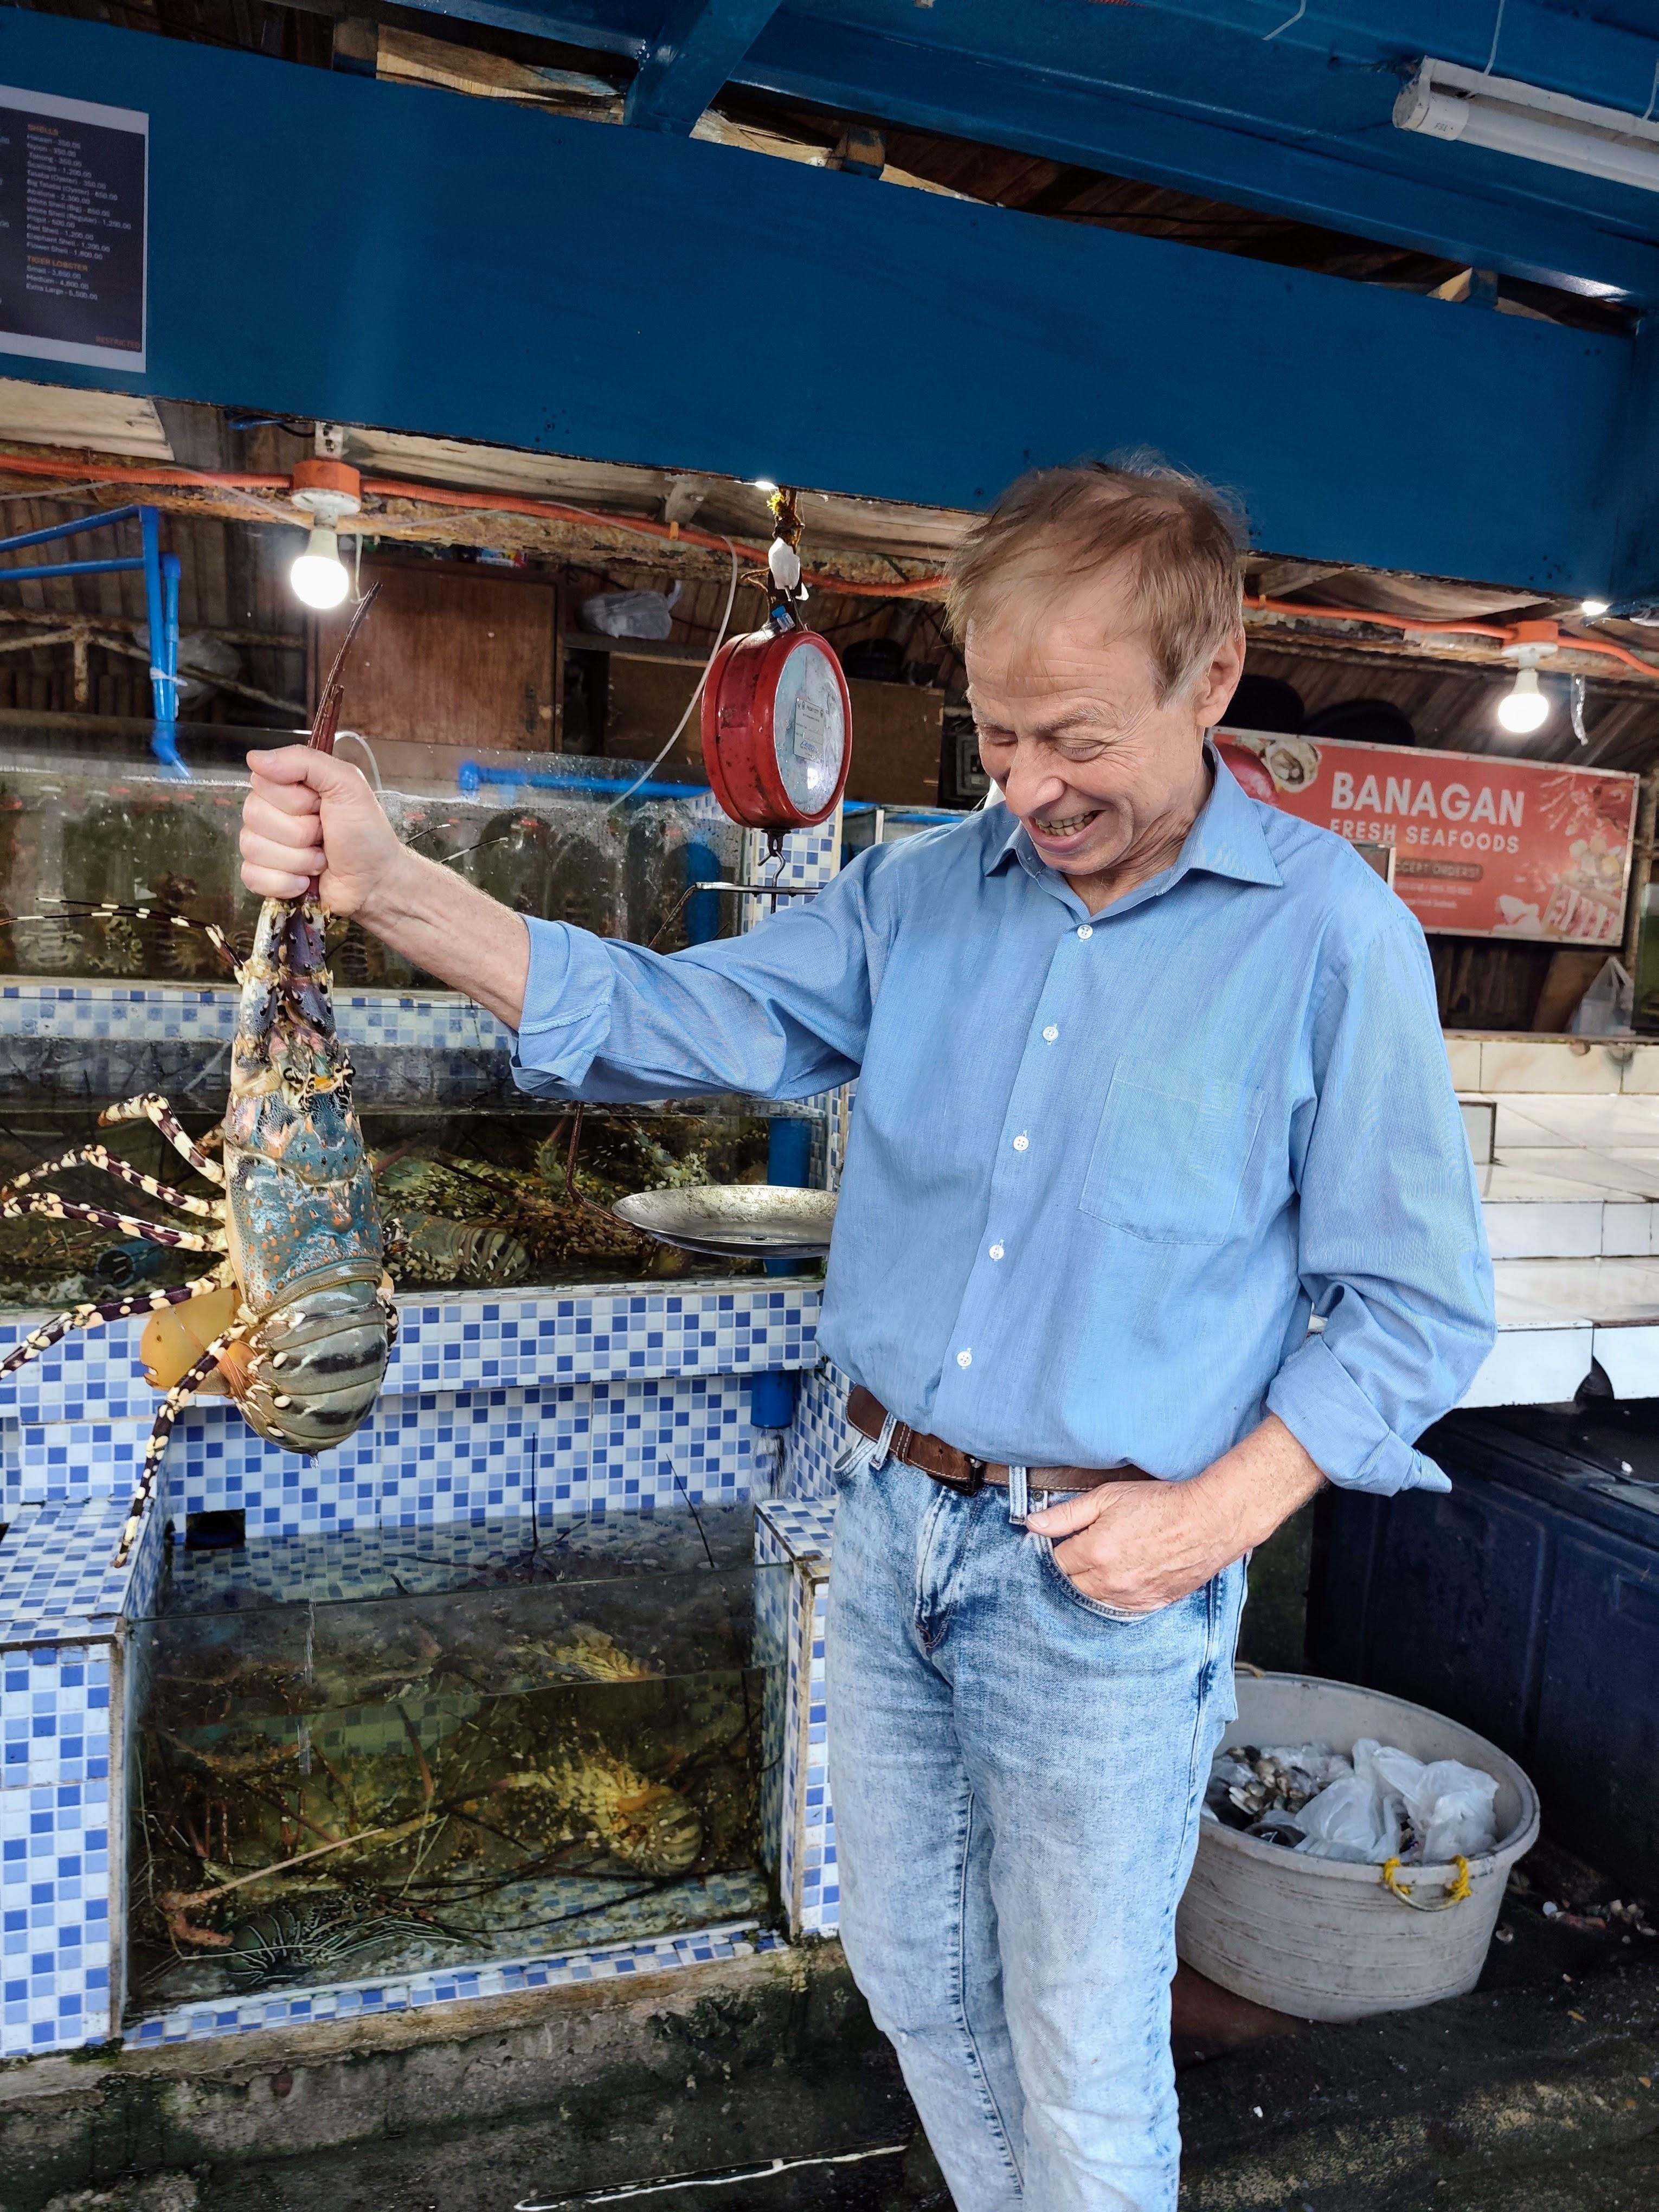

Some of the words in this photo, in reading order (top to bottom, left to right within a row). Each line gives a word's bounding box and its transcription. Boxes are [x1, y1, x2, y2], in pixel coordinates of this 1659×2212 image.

[27, 188, 55, 198] Abalone
[27, 197, 47, 206] White
[48, 201, 65, 209] Shell
[66, 204, 82, 214] (Big)
[27, 206, 47, 215] White
[48, 210, 65, 218] Shell
[66, 213, 97, 225] (Regular)
[27, 223, 41, 232] Red
[42, 226, 59, 235] Shell
[27, 233, 57, 245] Elephant
[58, 238, 75, 247] Shell
[27, 242, 49, 251] Flower
[51, 246, 68, 254] Shell
[27, 256, 51, 266] TIGER
[53, 260, 88, 272] LOBSTER
[27, 265, 46, 274] Small
[26, 274, 54, 284] Medium
[26, 283, 44, 291] Extra
[45, 286, 64, 296] Large
[1331, 771, 1525, 827] BANAGAN
[1330, 818, 1397, 841] FRESH
[1406, 825, 1520, 854] SEAFOODS
